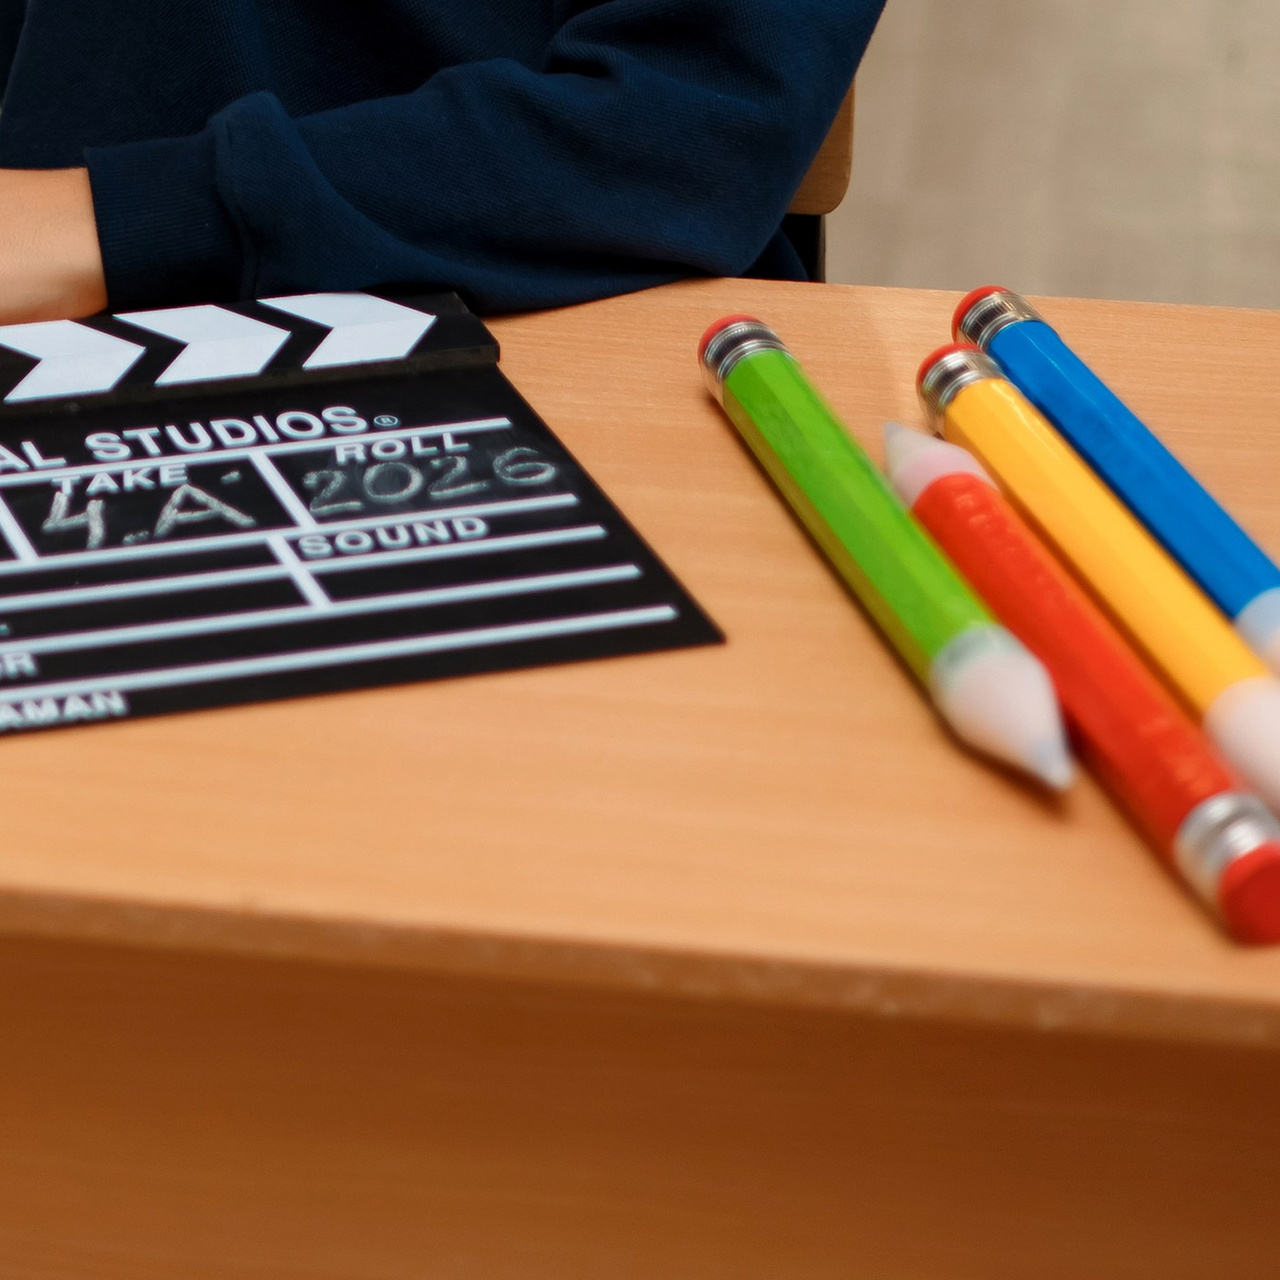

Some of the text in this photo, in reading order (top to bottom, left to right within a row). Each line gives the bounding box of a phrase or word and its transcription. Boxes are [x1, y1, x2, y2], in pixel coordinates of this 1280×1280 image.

[334, 432, 469, 465] ROLL
[51, 463, 188, 496] TAKE
[302, 447, 558, 517] 2026
[298, 516, 489, 558] SOUND
